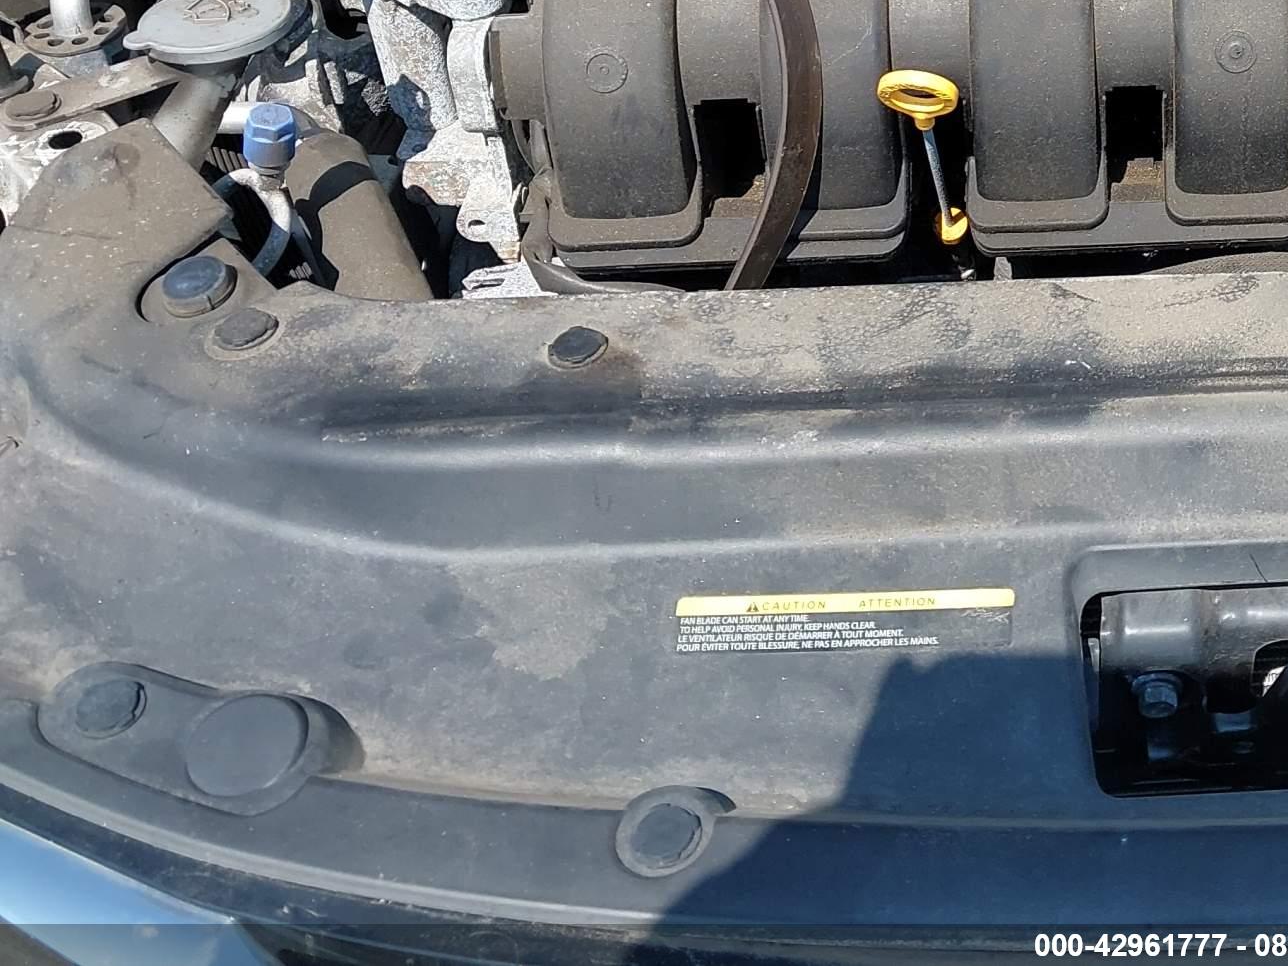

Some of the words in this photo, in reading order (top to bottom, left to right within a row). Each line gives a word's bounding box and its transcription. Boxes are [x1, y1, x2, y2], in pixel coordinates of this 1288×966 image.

[762, 601, 826, 611] CAUTION
[859, 598, 935, 608] ATTENTION
[776, 624, 802, 632] INJURY,
[689, 634, 742, 642] VENTILATEUR
[744, 633, 773, 641] RISQUE
[790, 630, 832, 640] DÉMARRER
[833, 630, 839, 639] À
[865, 629, 904, 637] MOMENT.
[702, 642, 728, 651] ÉVITER
[730, 642, 757, 650] TOUTE
[759, 641, 800, 650] BLESSURE,
[814, 640, 829, 648] PAS
[910, 637, 939, 645] MAINS.
